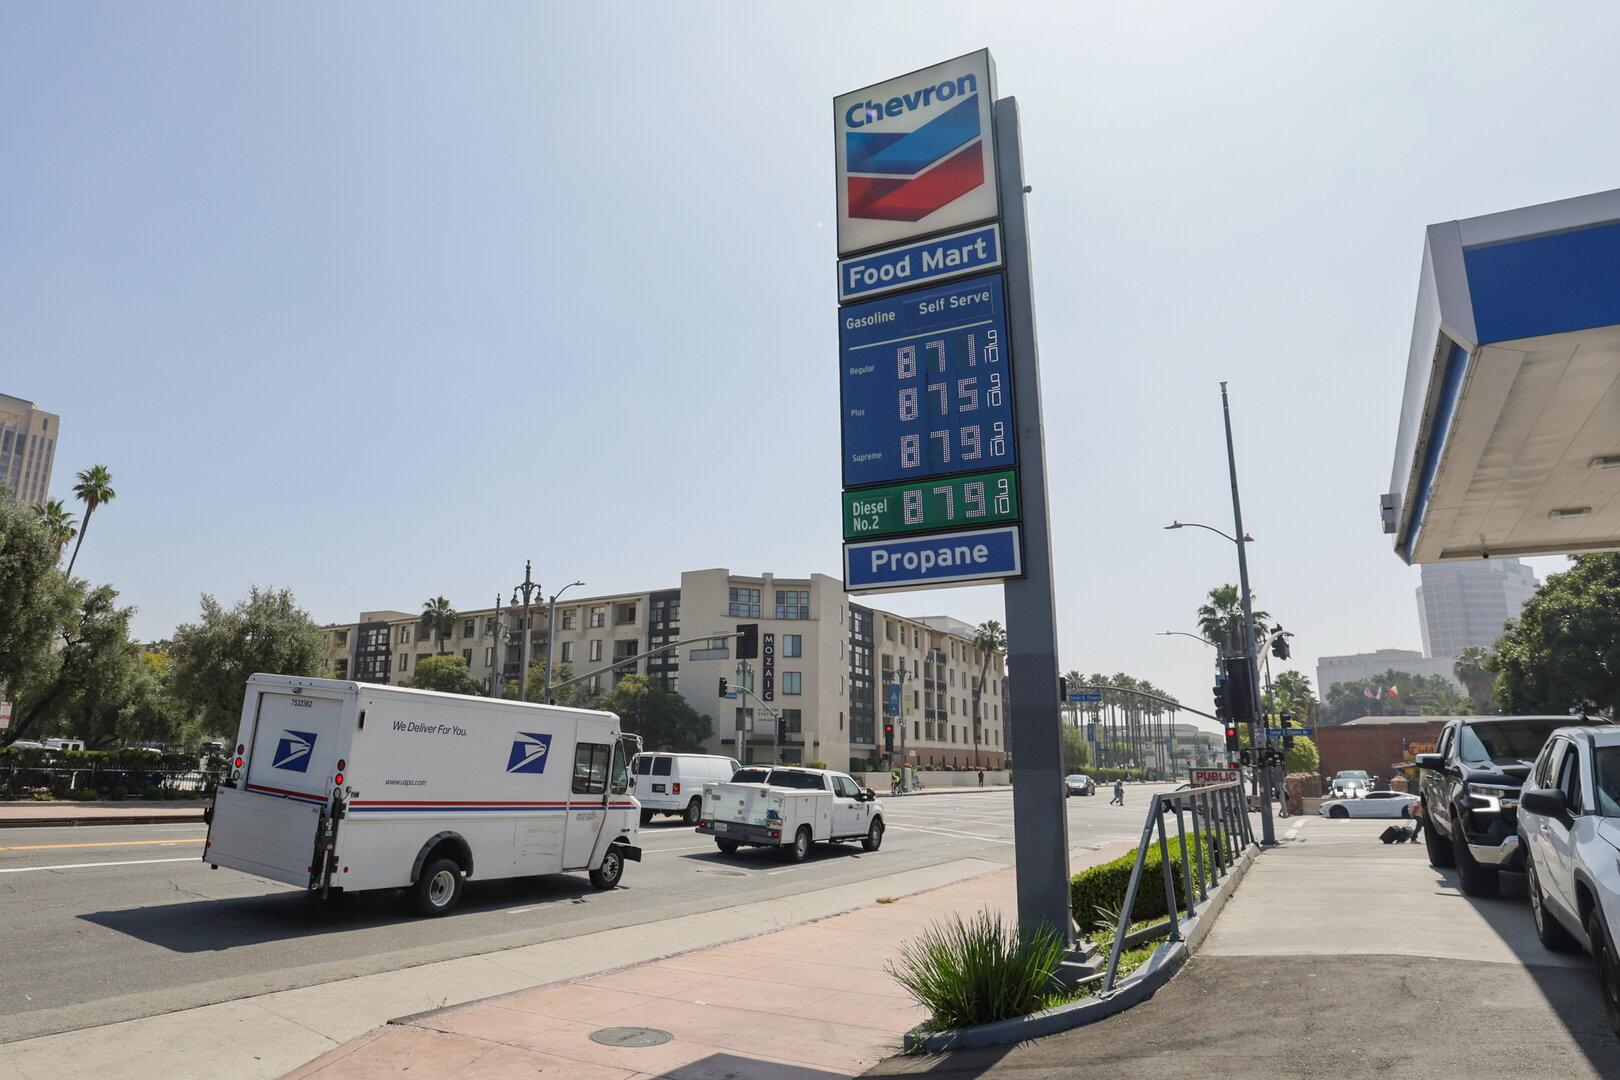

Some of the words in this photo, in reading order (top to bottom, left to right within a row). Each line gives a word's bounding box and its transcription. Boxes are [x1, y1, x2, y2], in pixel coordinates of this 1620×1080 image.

[846, 73, 977, 128] Chevron
[850, 255, 911, 289] Food
[922, 237, 987, 272] Mart
[846, 311, 896, 330] Gasoline
[919, 298, 945, 315] Self
[950, 291, 990, 308] Serve
[849, 364, 876, 376] Regular
[897, 333, 977, 379] 871
[850, 408, 866, 417] Plus
[899, 376, 979, 422] 875
[852, 452, 882, 464] Supreme
[901, 424, 982, 468] 879
[852, 498, 888, 516] Diesel
[903, 481, 987, 525] 879
[871, 543, 989, 574] Propane
[765, 635, 773, 699] MOZAIC
[392, 720, 407, 732] We
[407, 721, 438, 734] Deliver
[437, 724, 452, 735] For
[385, 779, 427, 787] www.usps.com
[1196, 771, 1237, 782] PUBLIC
